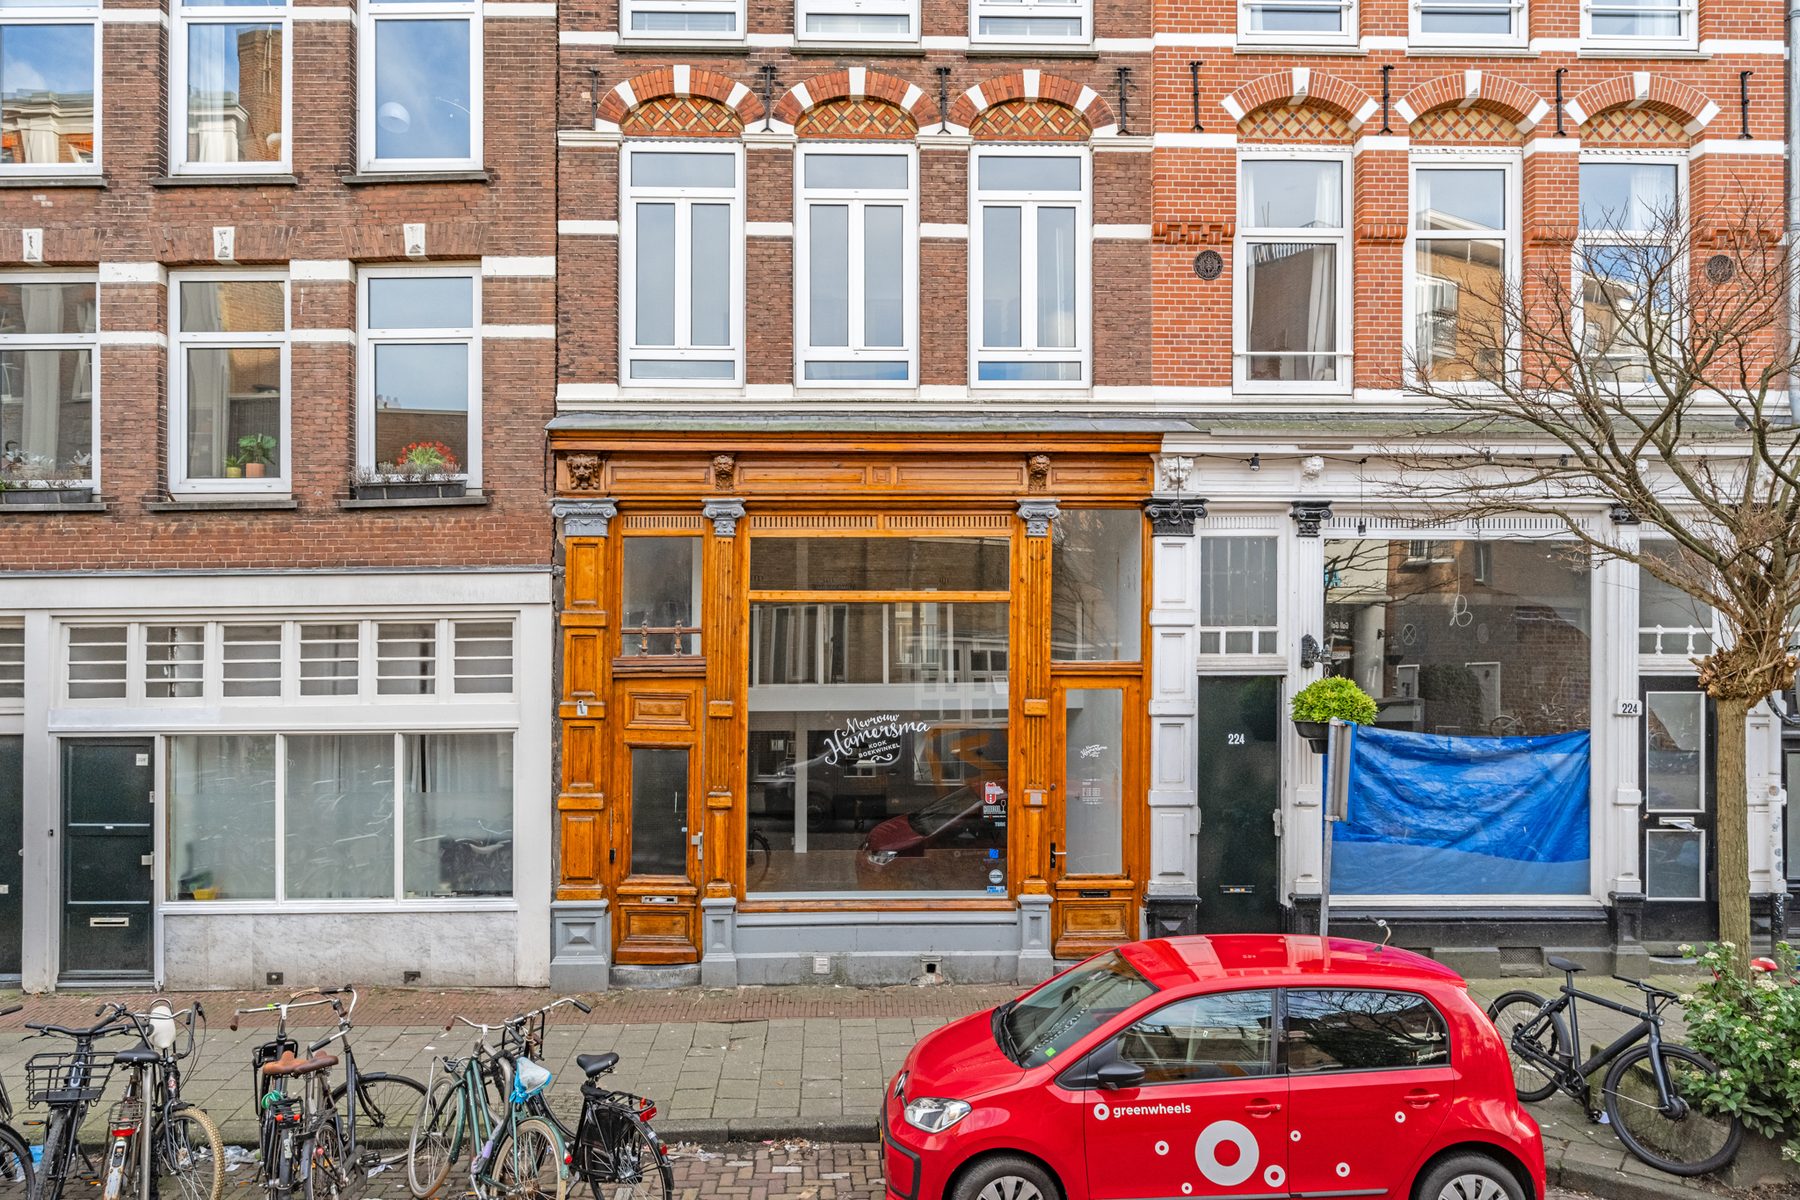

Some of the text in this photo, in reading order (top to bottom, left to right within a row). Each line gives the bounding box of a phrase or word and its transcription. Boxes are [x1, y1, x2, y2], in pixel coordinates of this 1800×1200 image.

[1622, 703, 1637, 713] 224
[842, 714, 899, 736] Mevrouw
[824, 721, 931, 765] Hamersma
[868, 740, 887, 749] KOOK
[1228, 733, 1245, 744] 224
[858, 743, 900, 758] BOEKWINKEL
[1113, 1103, 1191, 1118] greenwheels
